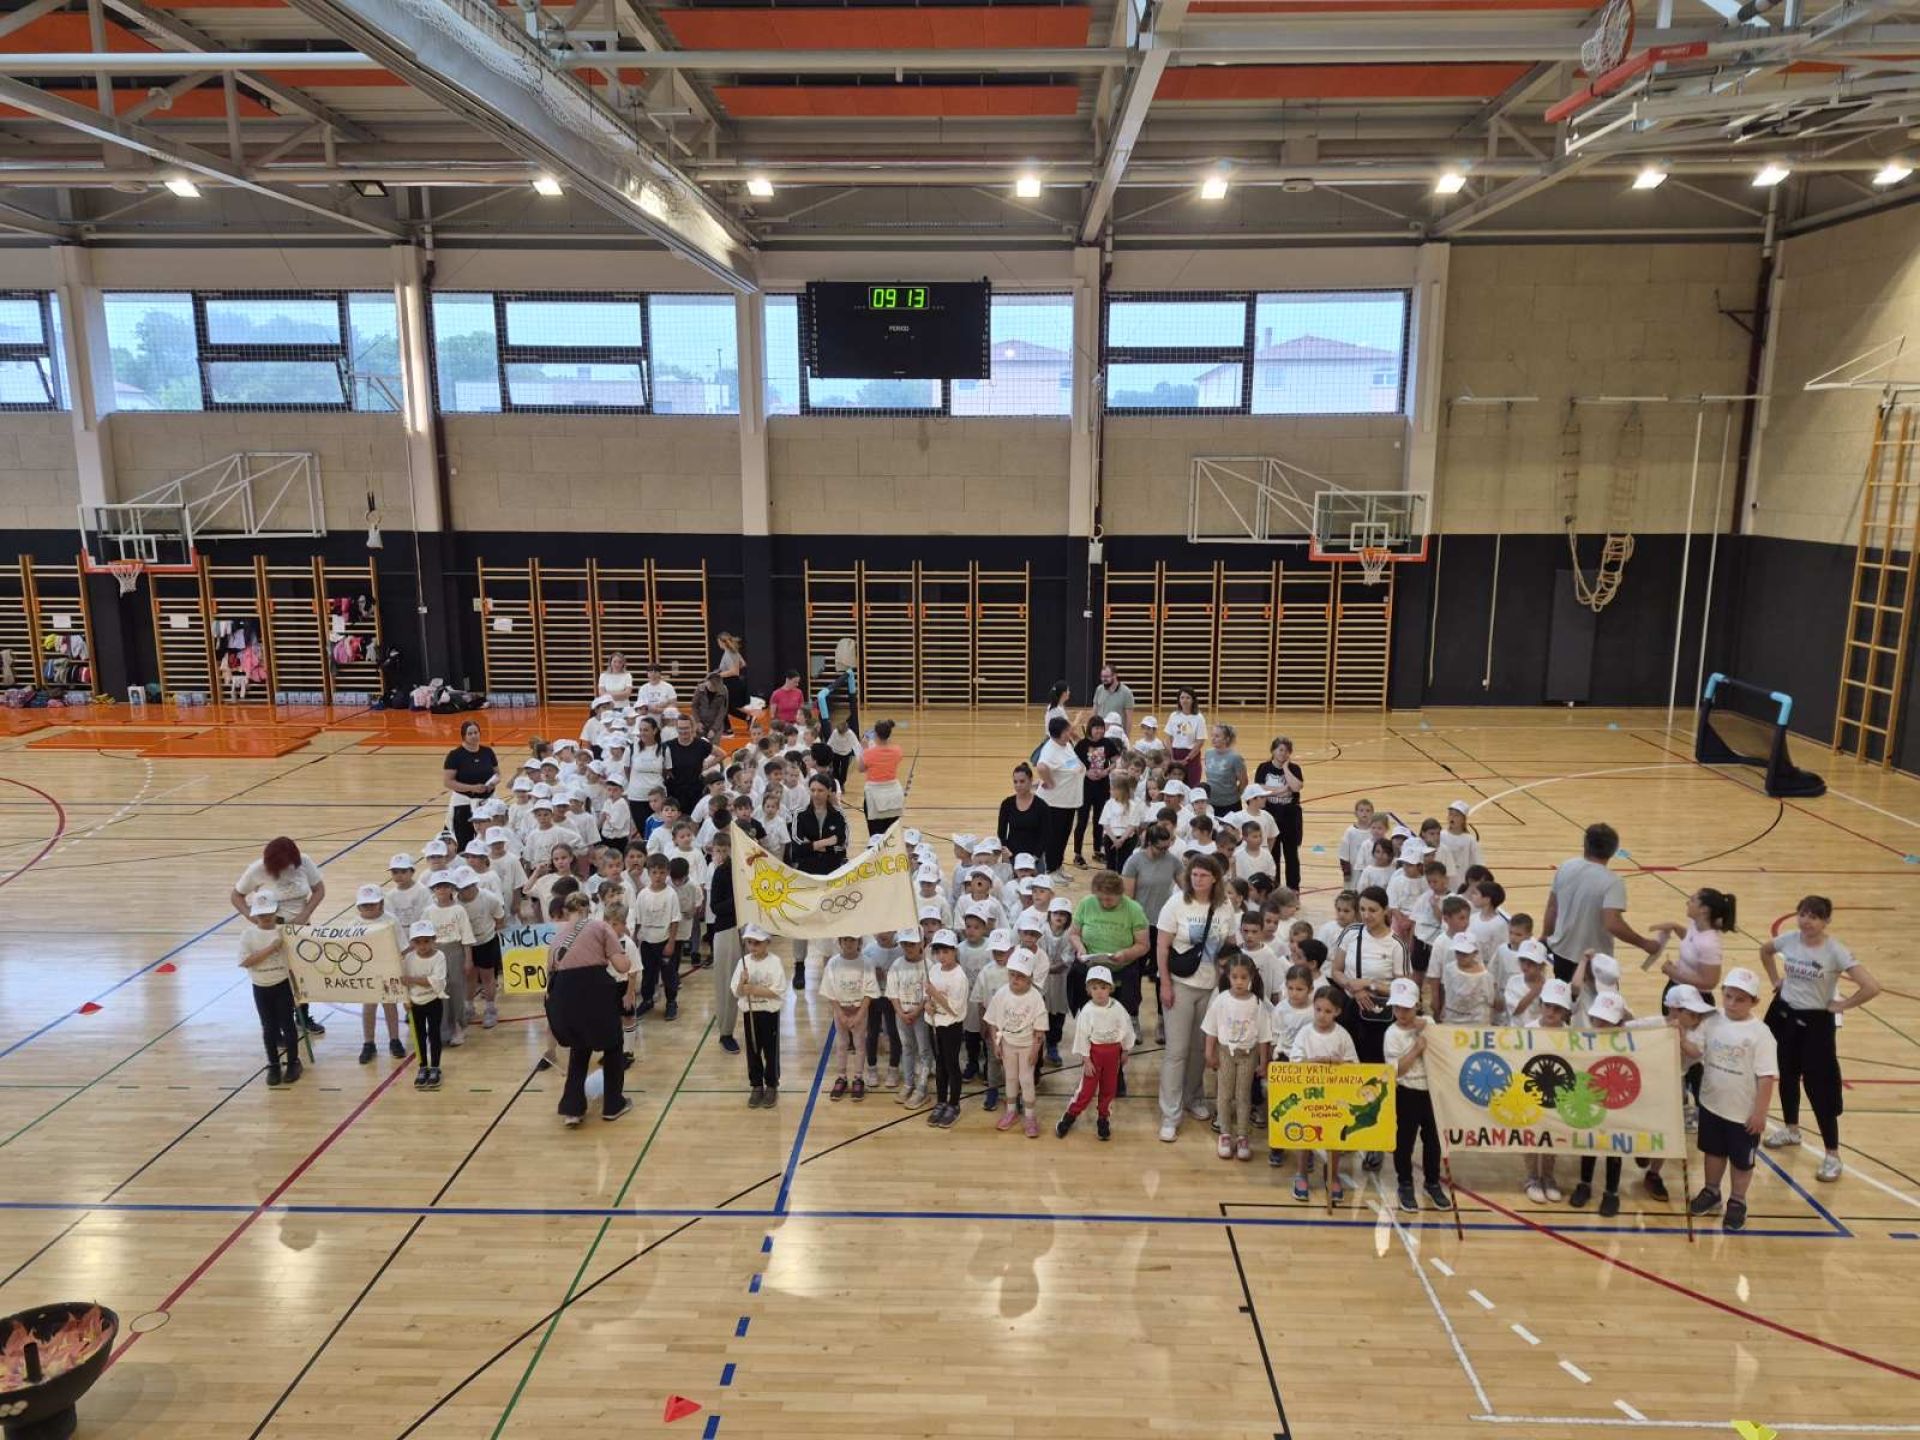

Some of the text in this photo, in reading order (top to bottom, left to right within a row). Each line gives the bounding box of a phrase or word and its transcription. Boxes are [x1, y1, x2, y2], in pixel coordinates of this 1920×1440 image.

[872, 287, 925, 309] 09 13
[310, 927, 369, 938] MEDULIN
[500, 925, 538, 948] MIĆI
[324, 977, 376, 989] RAKETE
[1443, 1127, 1553, 1147] UBAMARA
